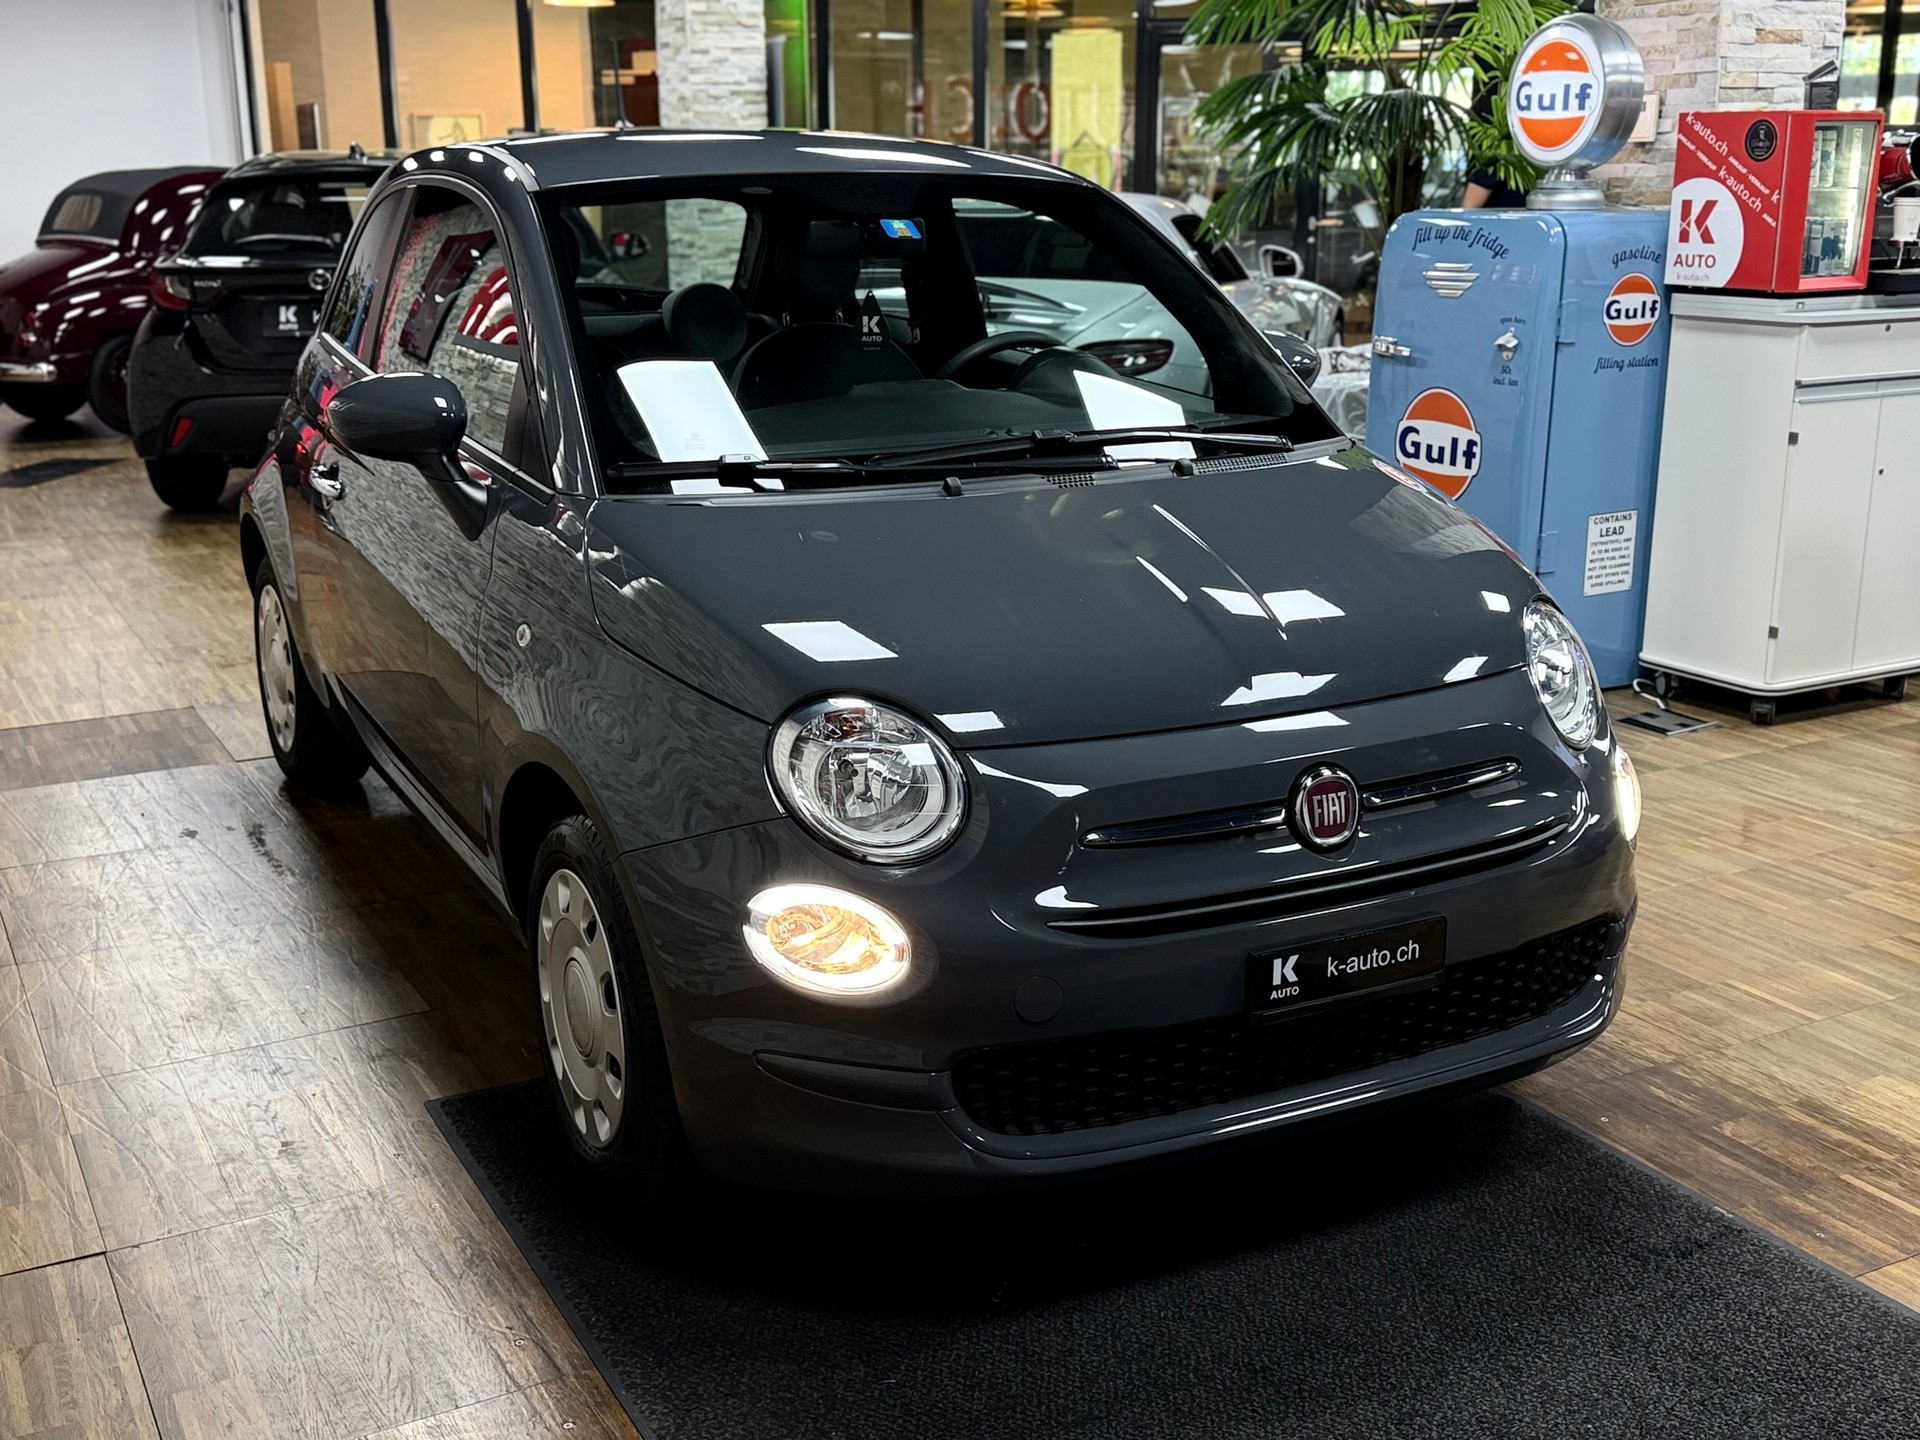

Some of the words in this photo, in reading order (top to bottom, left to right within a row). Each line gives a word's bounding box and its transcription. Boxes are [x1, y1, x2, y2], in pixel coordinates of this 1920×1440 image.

[1516, 80, 1593, 112] Gulf
[1685, 112, 1729, 156] k-auto.ch
[1718, 165, 1762, 213] k-auto.ch
[1678, 199, 1719, 244] K
[1411, 226, 1433, 251] fill
[1434, 226, 1451, 244] up
[1452, 225, 1473, 242] the
[1467, 227, 1510, 259] fridge
[1612, 245, 1662, 269] gasoline
[1673, 253, 1717, 269] AUTO
[1676, 272, 1710, 281] k-auto.ch
[279, 305, 298, 323] K
[1605, 299, 1659, 320] Gulf
[862, 315, 881, 333] K
[1593, 357, 1625, 374] filling
[1627, 355, 1659, 368] station
[1398, 425, 1478, 470] Gulf
[1593, 513, 1632, 525] CONTAINS
[1599, 525, 1625, 538] LEAD
[1312, 790, 1347, 828] FIAT
[1272, 954, 1300, 986] K
[1327, 939, 1420, 978] k-auto.ch
[1270, 986, 1300, 1000] AUTO
